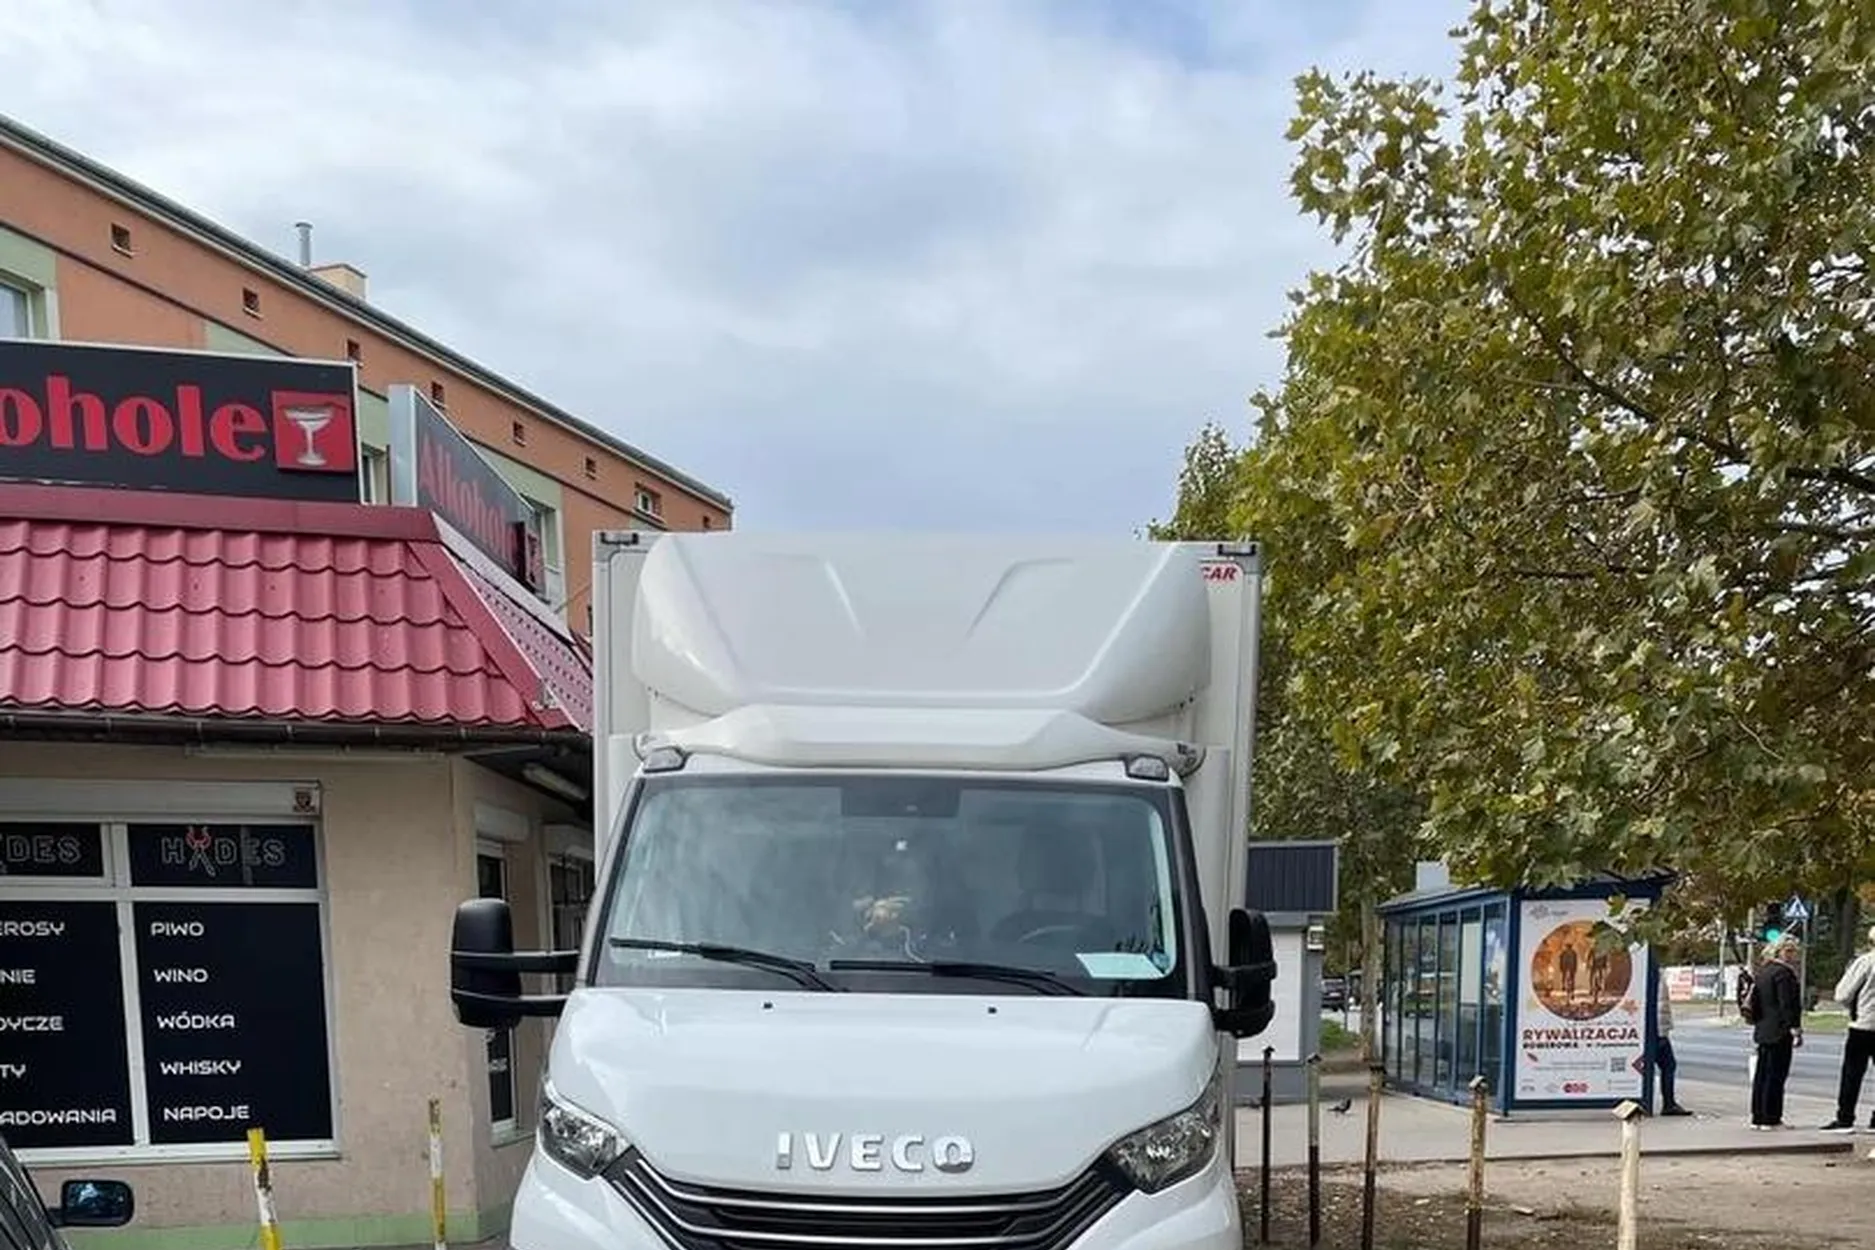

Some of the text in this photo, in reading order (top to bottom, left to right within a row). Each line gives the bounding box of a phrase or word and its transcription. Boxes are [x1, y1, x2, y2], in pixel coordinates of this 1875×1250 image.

[0, 375, 268, 461] ohole
[0, 834, 82, 864] DES
[0, 921, 65, 936] ROSY
[151, 922, 205, 937] PIWO
[0, 968, 36, 984] NIE
[153, 968, 209, 983] WINO
[156, 1011, 235, 1029] WÓDKA
[1522, 1027, 1639, 1041] RYWALIZACJA
[160, 1060, 242, 1075] WHISKY
[0, 1108, 117, 1125] ADOWANIA
[163, 1105, 251, 1121] NAPOJE
[776, 1131, 975, 1174] IVECO
